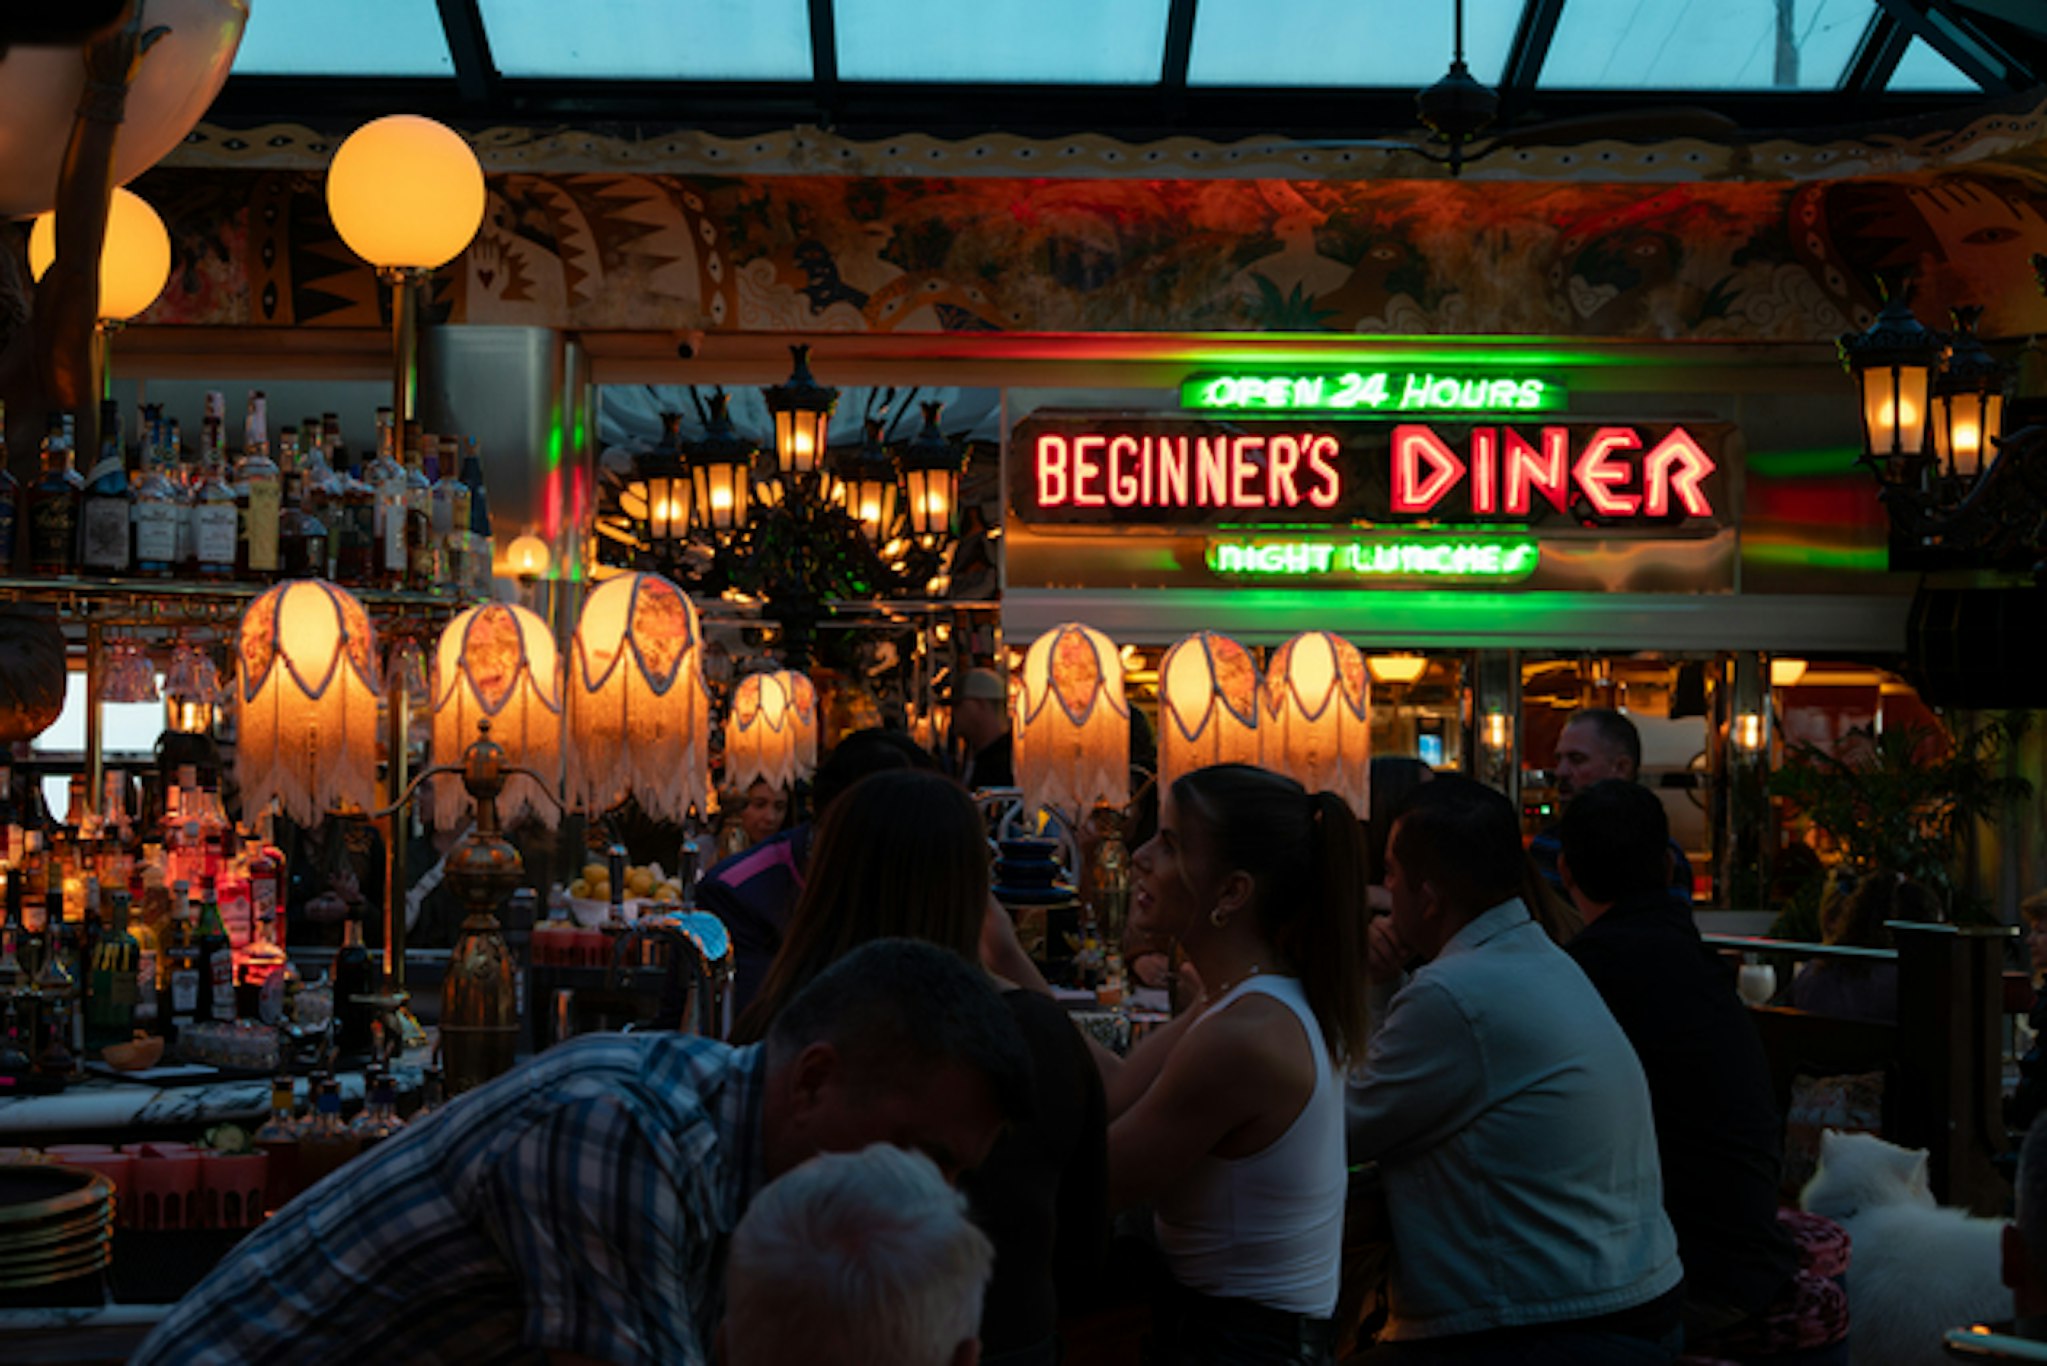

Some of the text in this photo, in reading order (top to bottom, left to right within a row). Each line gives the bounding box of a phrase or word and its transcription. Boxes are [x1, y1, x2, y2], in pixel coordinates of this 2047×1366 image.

[1206, 372, 1544, 409] OPEN 24 HOURS
[1037, 424, 1716, 517] BEGINNER'S DINER
[1217, 543, 1334, 573] NIGHT
